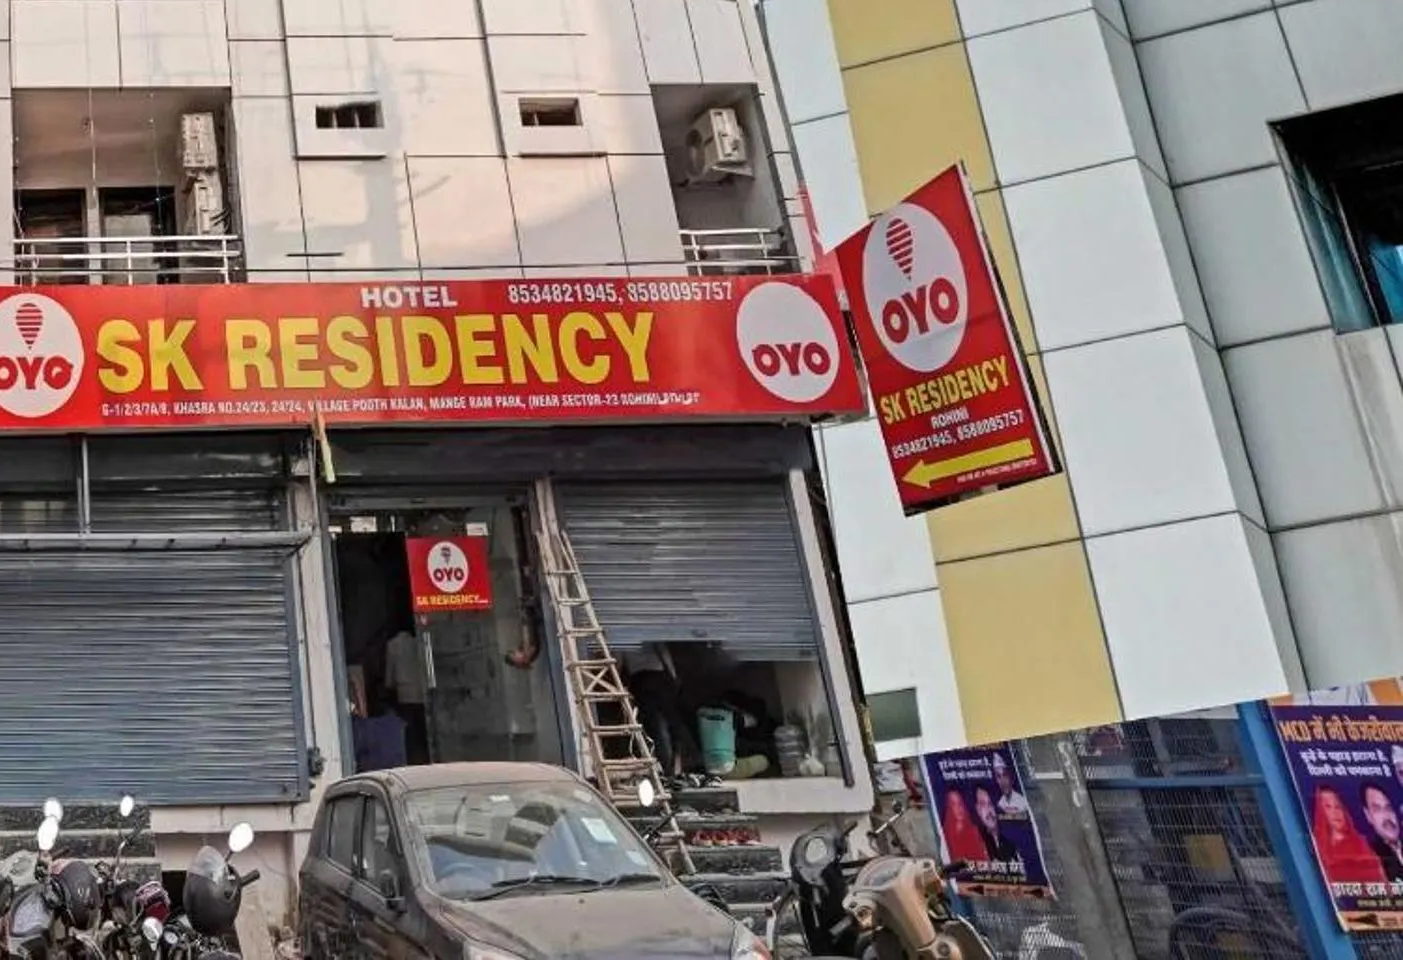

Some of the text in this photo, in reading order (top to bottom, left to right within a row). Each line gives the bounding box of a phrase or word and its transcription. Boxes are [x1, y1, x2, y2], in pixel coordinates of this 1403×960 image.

[361, 285, 458, 308] HOTEL
[882, 277, 959, 344] OYO
[96, 311, 653, 394] SK RESIDENCY
[752, 341, 831, 377] OYO
[880, 354, 1009, 425] SK RESIDENCY
[433, 567, 464, 582] OYO
